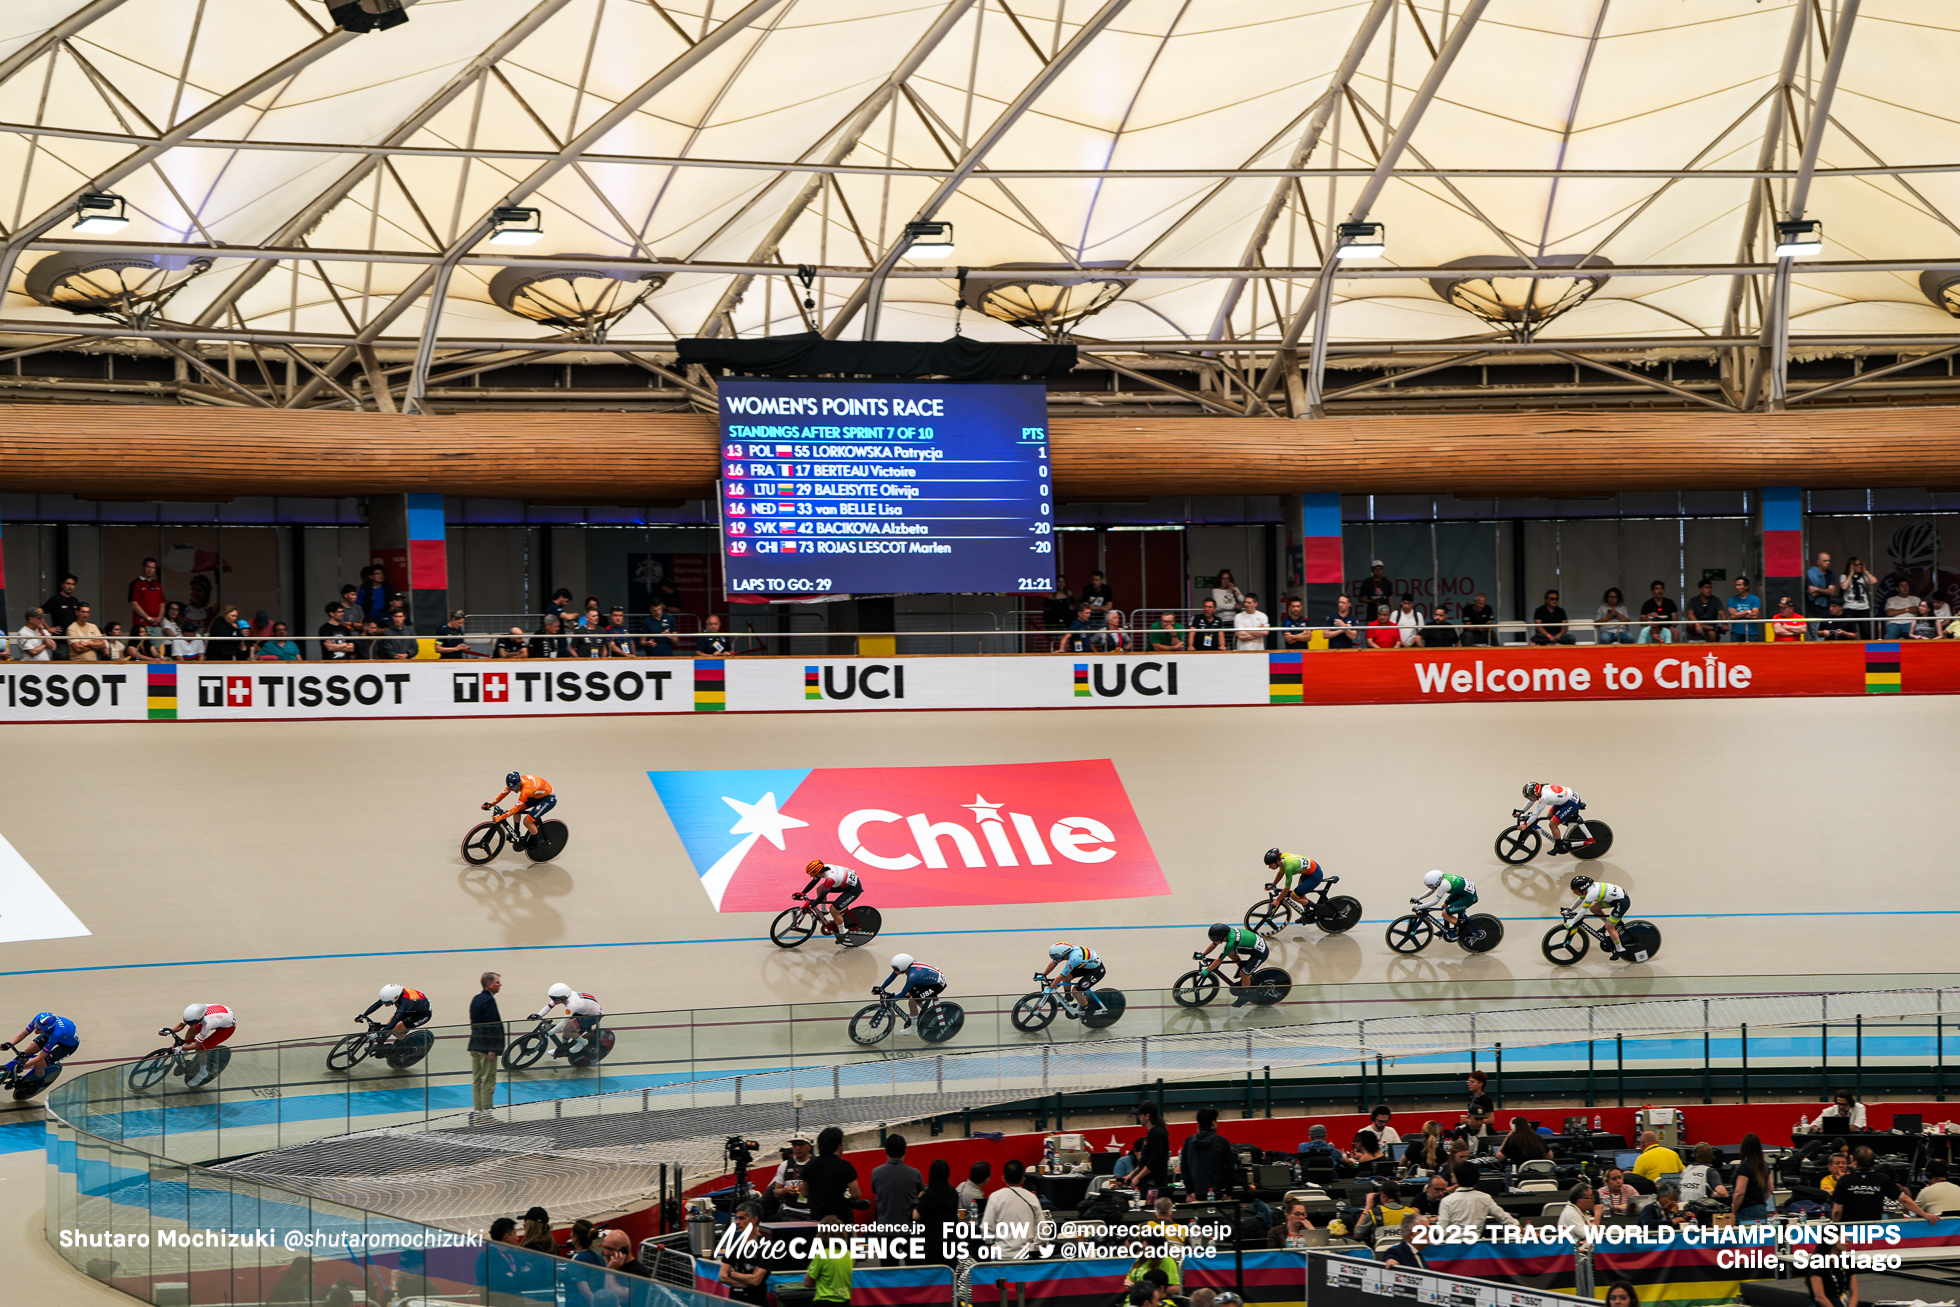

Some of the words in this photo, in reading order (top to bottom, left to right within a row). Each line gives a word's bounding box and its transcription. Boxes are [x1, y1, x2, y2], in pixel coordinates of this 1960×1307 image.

[726, 396, 818, 415] WOMEN'S
[822, 398, 889, 416] POINTS
[893, 398, 944, 417] RACE
[729, 425, 800, 438] STANDINGS
[801, 426, 841, 439] AFTER
[843, 426, 884, 439] SPRINT
[886, 427, 895, 439] 7
[897, 427, 916, 440] OF
[918, 428, 934, 440] 10
[1021, 428, 1045, 440] PTS
[726, 444, 743, 457] 13
[749, 445, 774, 457] POL
[794, 445, 810, 457] 55
[813, 445, 893, 459] LORKOWSKA
[894, 446, 943, 461] Patrycja
[1038, 447, 1047, 458] 1
[727, 464, 744, 476] 16
[750, 464, 775, 477] FRA
[795, 464, 811, 477] 17
[813, 464, 869, 477] BERTEAU
[870, 465, 916, 477] Victoire
[1038, 465, 1048, 478] 0
[728, 483, 745, 496] 16
[753, 483, 776, 496] LTU
[796, 484, 812, 496] 29
[814, 484, 878, 496] BALEISYTE
[880, 484, 919, 499] Olivija
[1039, 484, 1049, 497] 0
[729, 502, 746, 515] 16
[751, 503, 777, 515] NED
[796, 503, 813, 515] 33
[815, 505, 838, 515] van
[839, 503, 876, 515] BELLE
[878, 503, 902, 515] Lisa
[1040, 503, 1050, 516] 0
[730, 521, 746, 534] 19
[753, 522, 778, 534] SVK
[797, 522, 814, 534] 42
[816, 522, 880, 535] BACIKOVA
[881, 522, 929, 535] Alzbeta
[1028, 523, 1051, 535] -20
[731, 541, 747, 553] 19
[755, 541, 778, 553] CHI
[798, 541, 815, 553] 73
[817, 541, 857, 555] ROJAS
[858, 541, 907, 554] LESCOT
[908, 541, 952, 554] Marlen
[1029, 541, 1051, 554] -20
[732, 578, 765, 591] LAPS
[766, 578, 785, 591] TO
[787, 578, 814, 591] GO:
[815, 578, 832, 591] 29
[1017, 577, 1053, 591] 21:21
[1345, 575, 1474, 598] VEDROMO
[823, 664, 904, 700] UCI
[1093, 661, 1178, 698] UCI
[1414, 660, 1591, 693] Welcome
[1603, 663, 1643, 690] to
[1653, 652, 1752, 689] Chile
[0, 673, 126, 708] ISSOT
[259, 673, 411, 708] TISSOT
[515, 670, 672, 702] TISSOT
[837, 793, 1118, 870] Chile
[919, 988, 935, 999] USA
